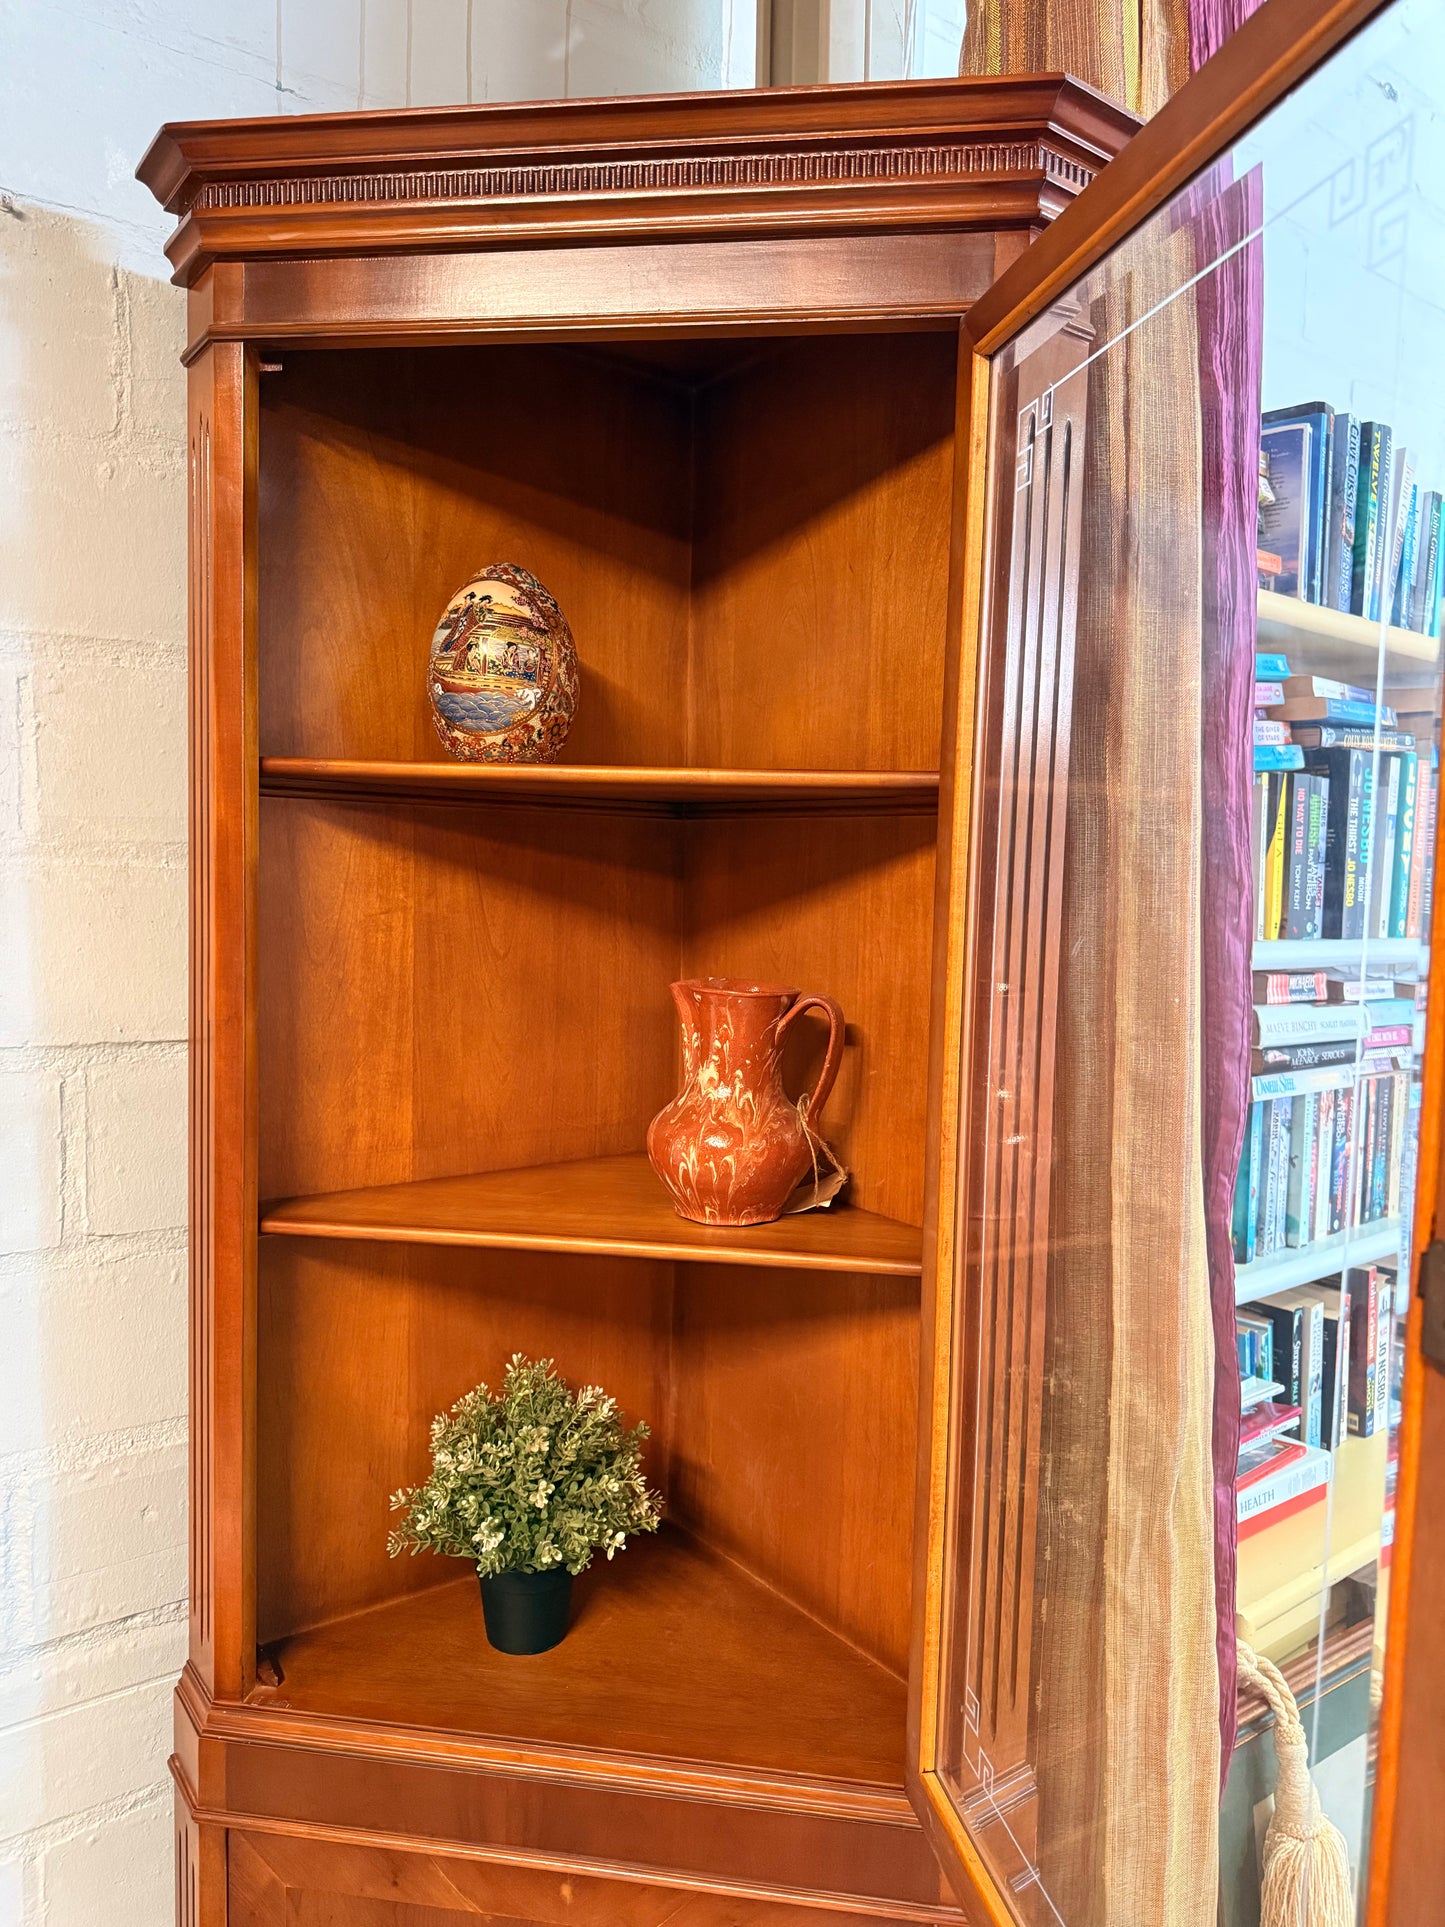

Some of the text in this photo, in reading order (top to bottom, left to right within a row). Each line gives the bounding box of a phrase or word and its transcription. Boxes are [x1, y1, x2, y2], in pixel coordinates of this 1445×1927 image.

[1370, 430, 1381, 502] TWELVE
[1431, 511, 1441, 535] John
[1428, 537, 1438, 581] Grisham
[1294, 788, 1305, 855] NO WAY TO DIE
[1348, 797, 1359, 853] THE THIRST
[1294, 864, 1302, 887] TONY
[1346, 858, 1356, 907] JO NESBO
[1368, 1278, 1377, 1358] John Grisham
[1377, 1341, 1386, 1401] JO NESBO
[1240, 1488, 1275, 1514] HEALTH
